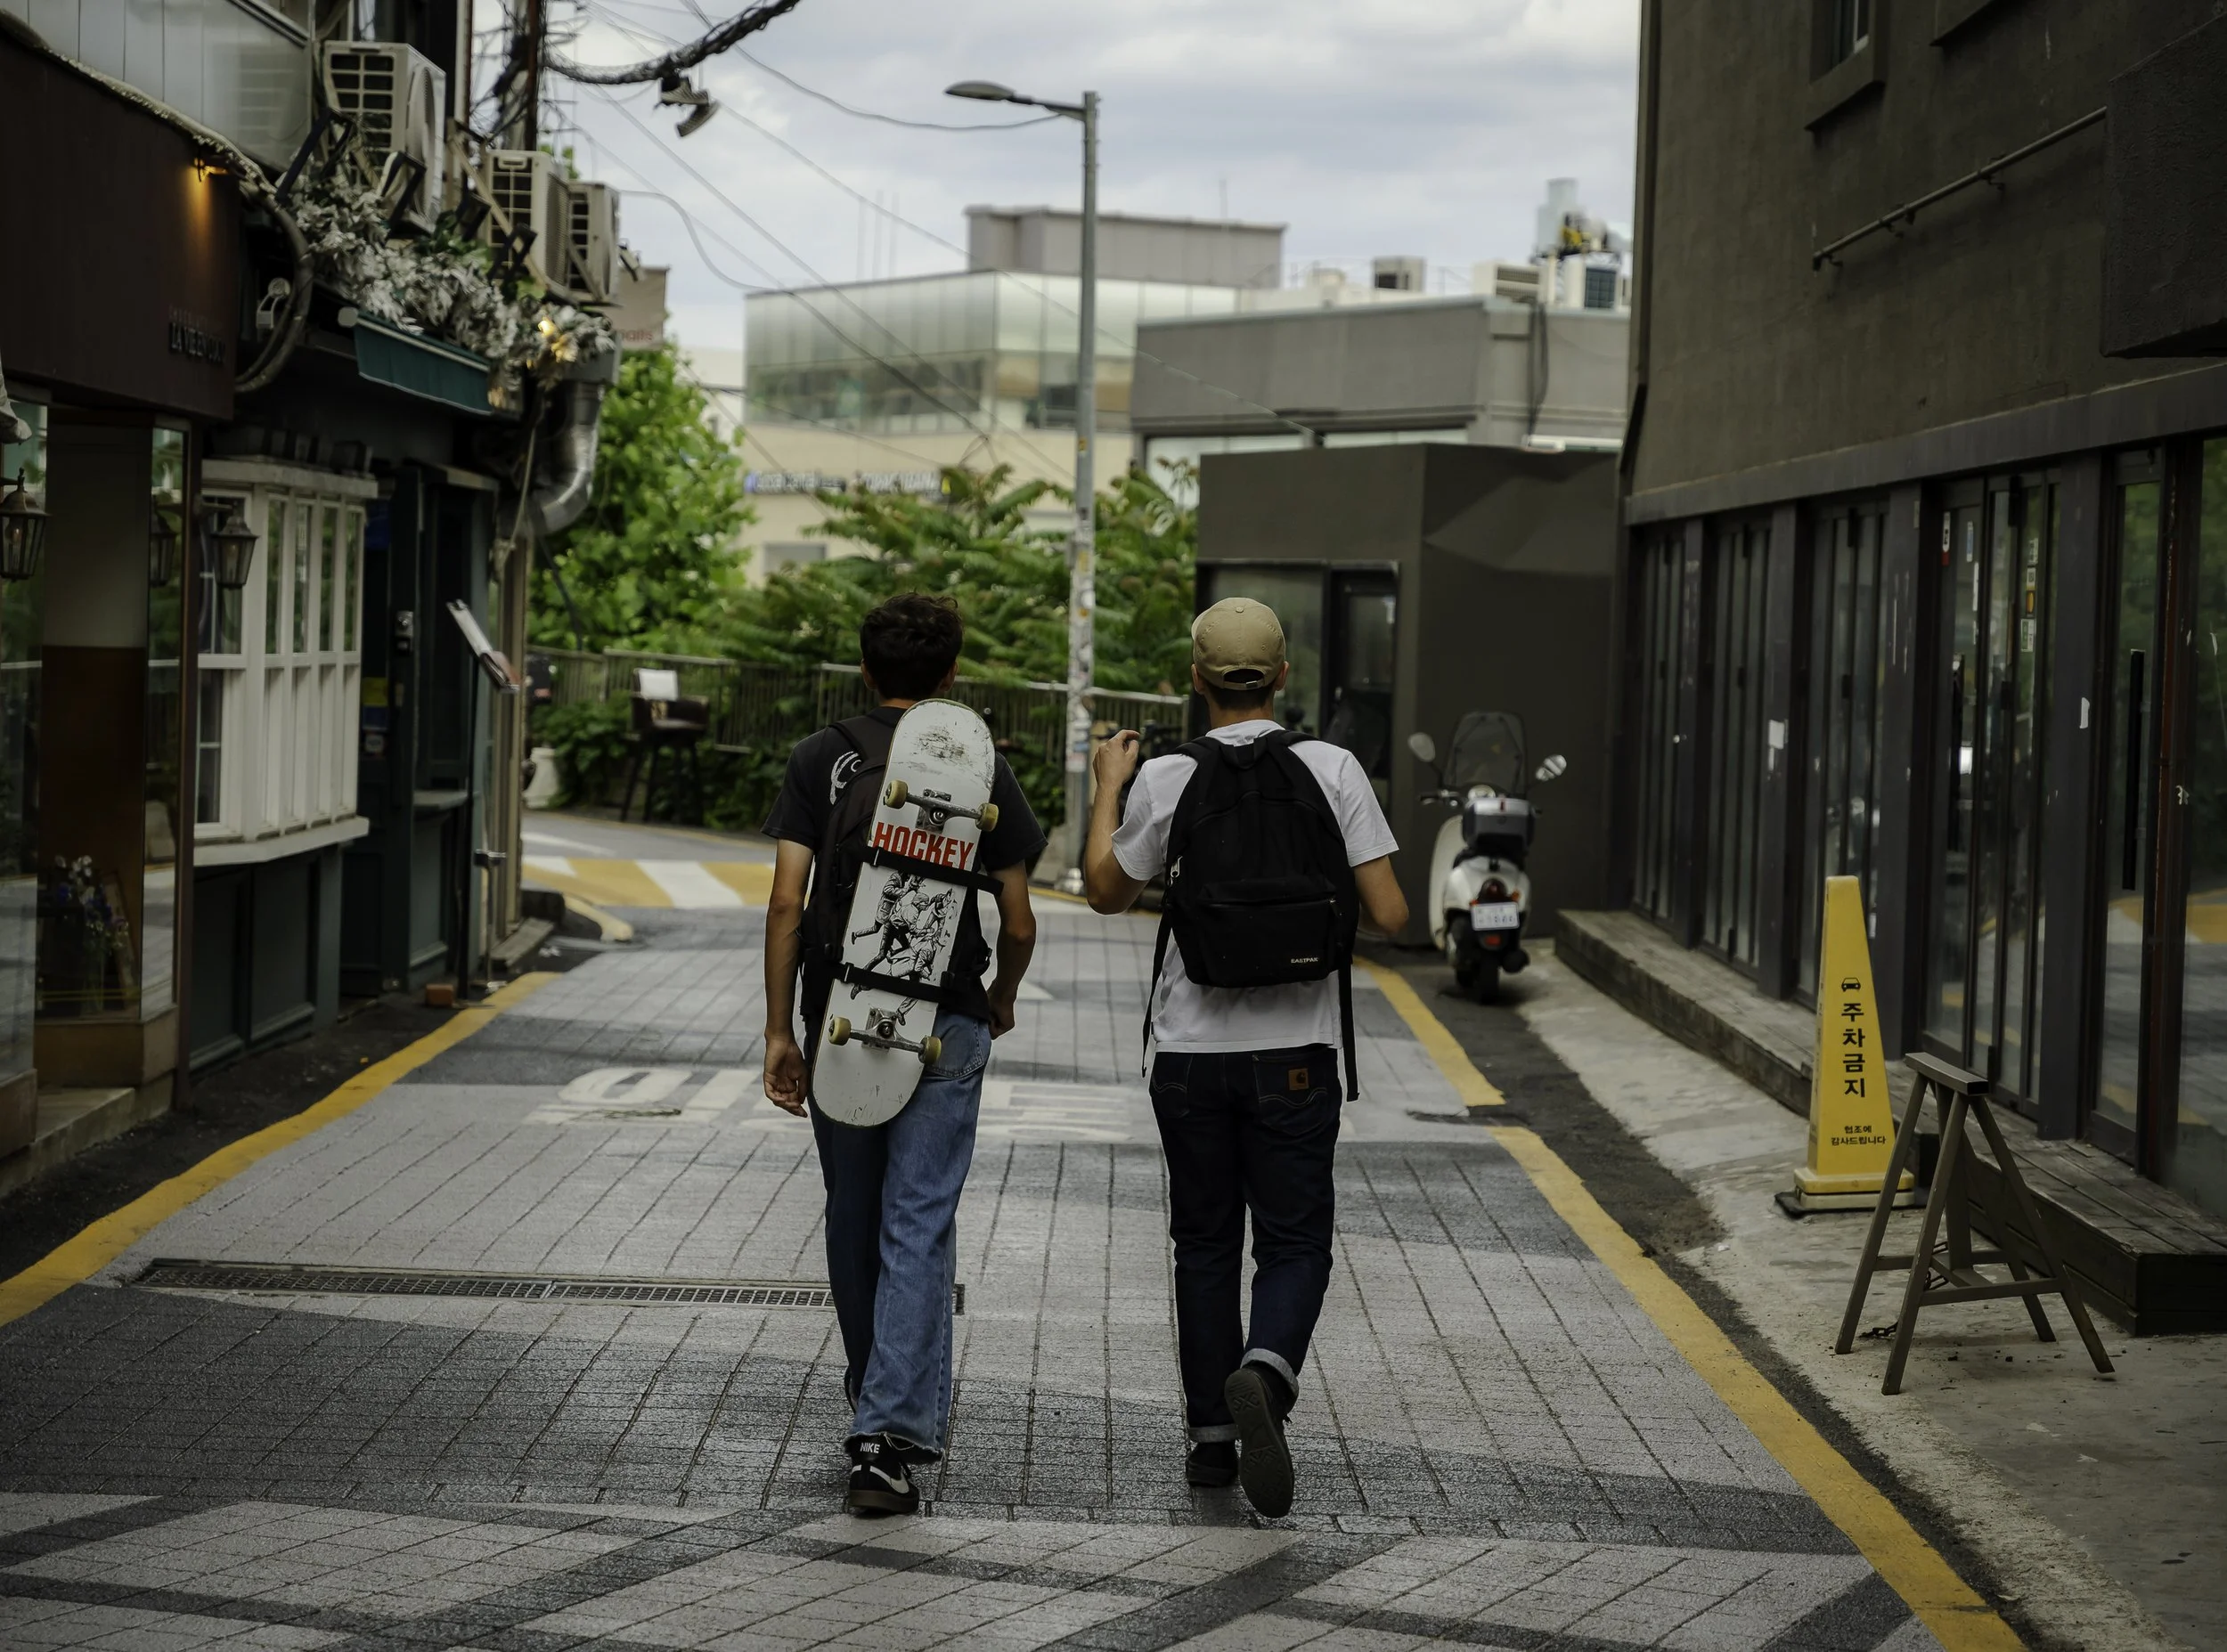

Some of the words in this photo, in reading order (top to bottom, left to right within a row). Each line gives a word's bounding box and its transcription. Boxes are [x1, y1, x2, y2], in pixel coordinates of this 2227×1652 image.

[873, 821, 975, 870] HOCKEY
[1841, 1003, 1865, 1098] 주차금지
[1844, 1125, 1872, 1134] 협조에
[1831, 1135, 1887, 1146] 감사드립니다
[861, 1442, 880, 1453] NIKE
